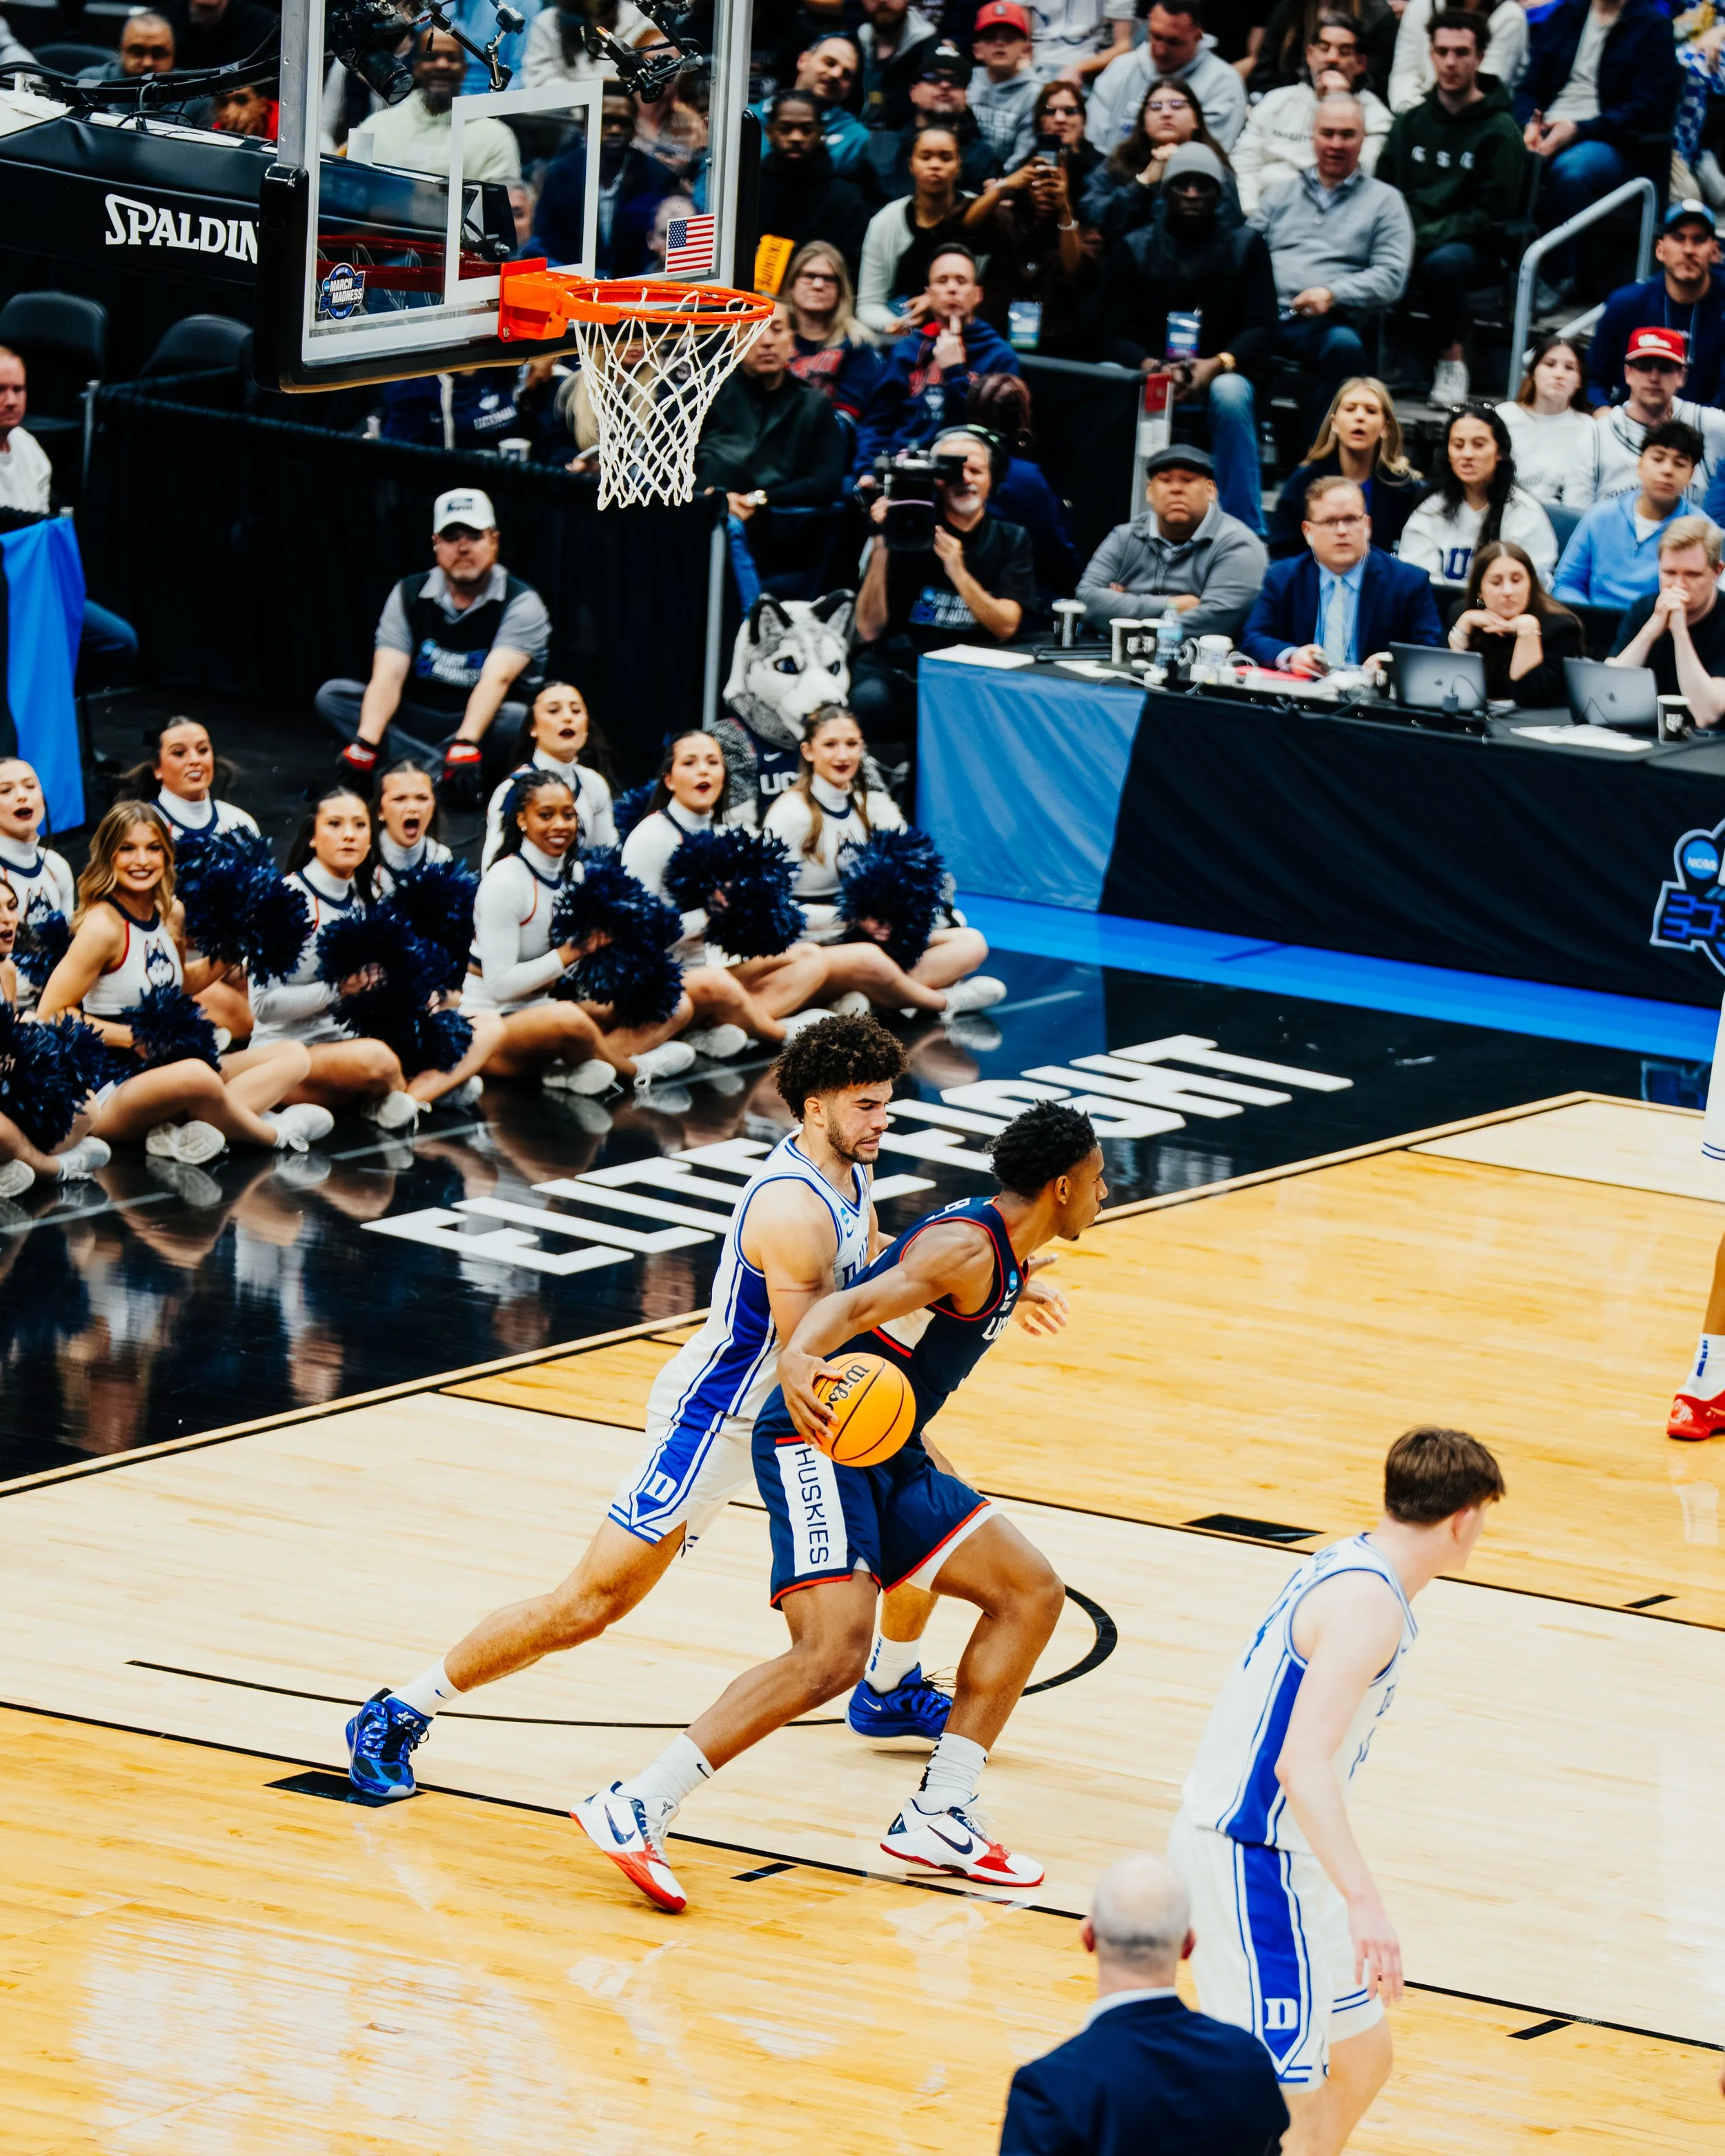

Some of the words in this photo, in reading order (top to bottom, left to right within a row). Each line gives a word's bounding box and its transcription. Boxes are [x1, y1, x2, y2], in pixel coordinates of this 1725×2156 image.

[105, 193, 259, 265] SPALDIN
[330, 277, 353, 293] MARCH
[332, 288, 363, 304] MADNESS
[1686, 856, 1718, 873] NCAA
[823, 1364, 870, 1412] Wils
[643, 1470, 678, 1503] D
[794, 1447, 829, 1565] HUSKIES
[1263, 1997, 1299, 2030] D
